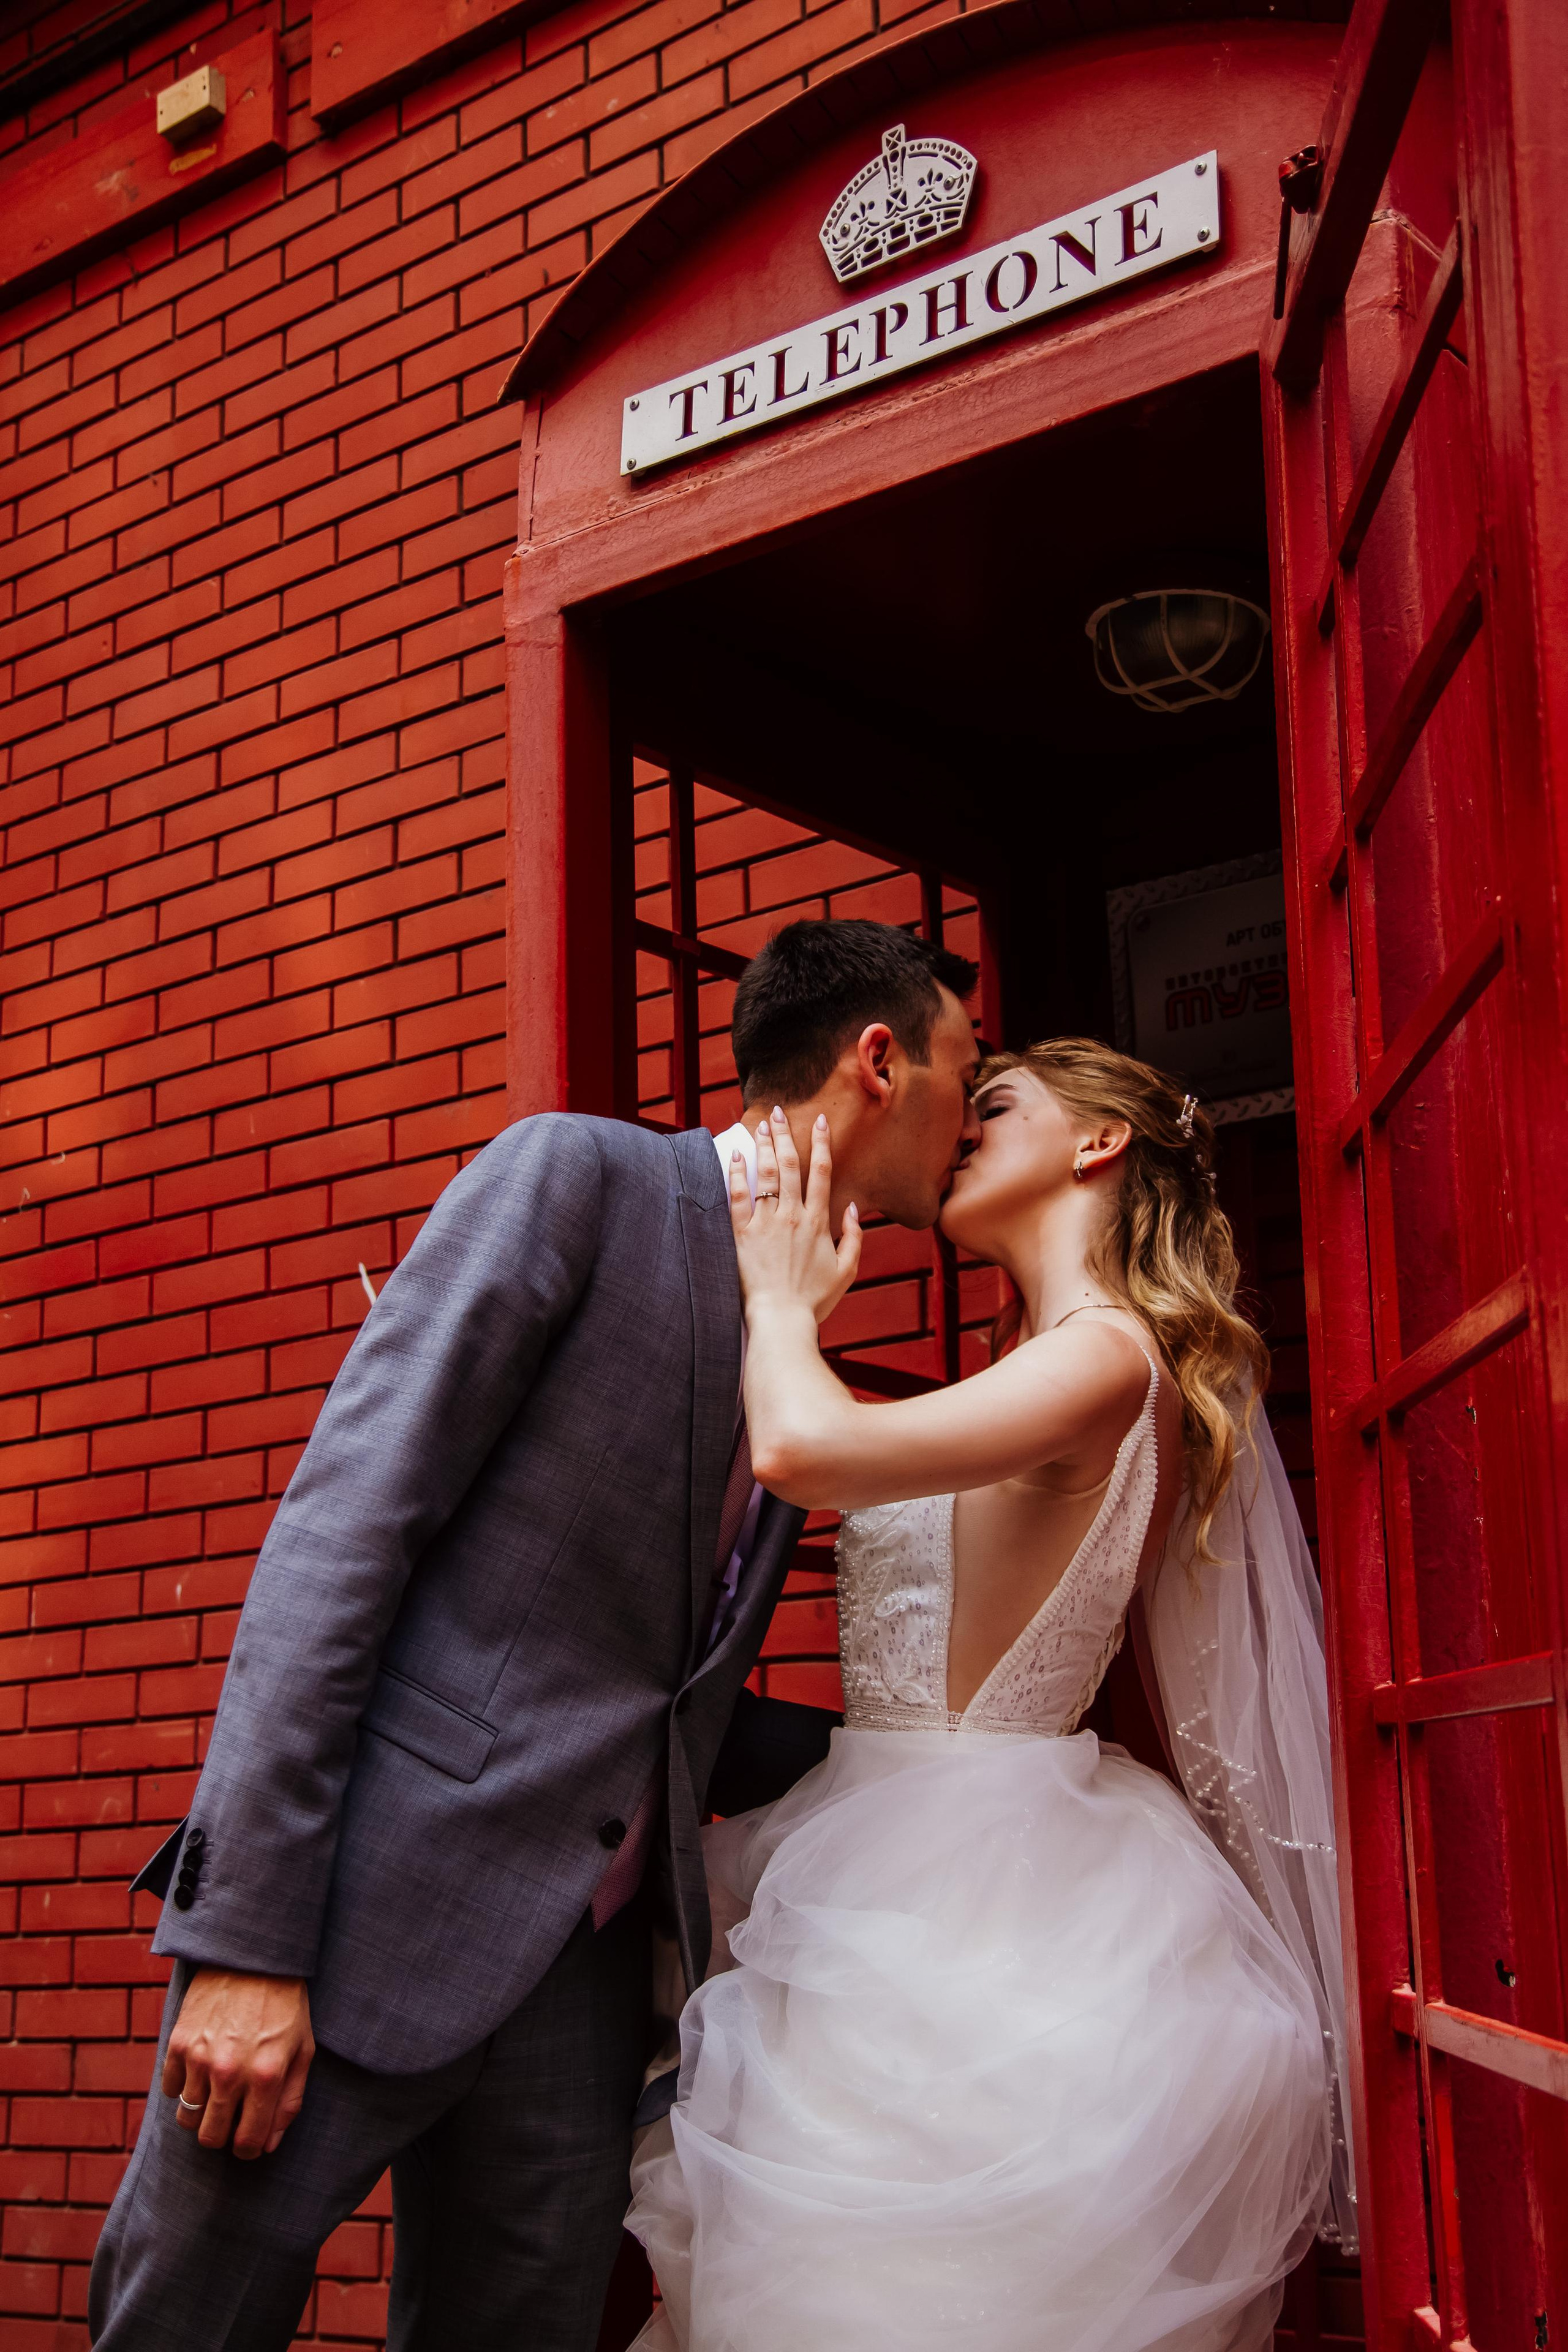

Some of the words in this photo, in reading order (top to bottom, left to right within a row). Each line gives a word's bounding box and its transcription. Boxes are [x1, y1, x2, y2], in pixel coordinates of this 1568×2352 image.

[669, 191, 1164, 441] TELEPHONE
[1227, 927, 1254, 946] АРТ
[1261, 921, 1286, 938] ОБ
